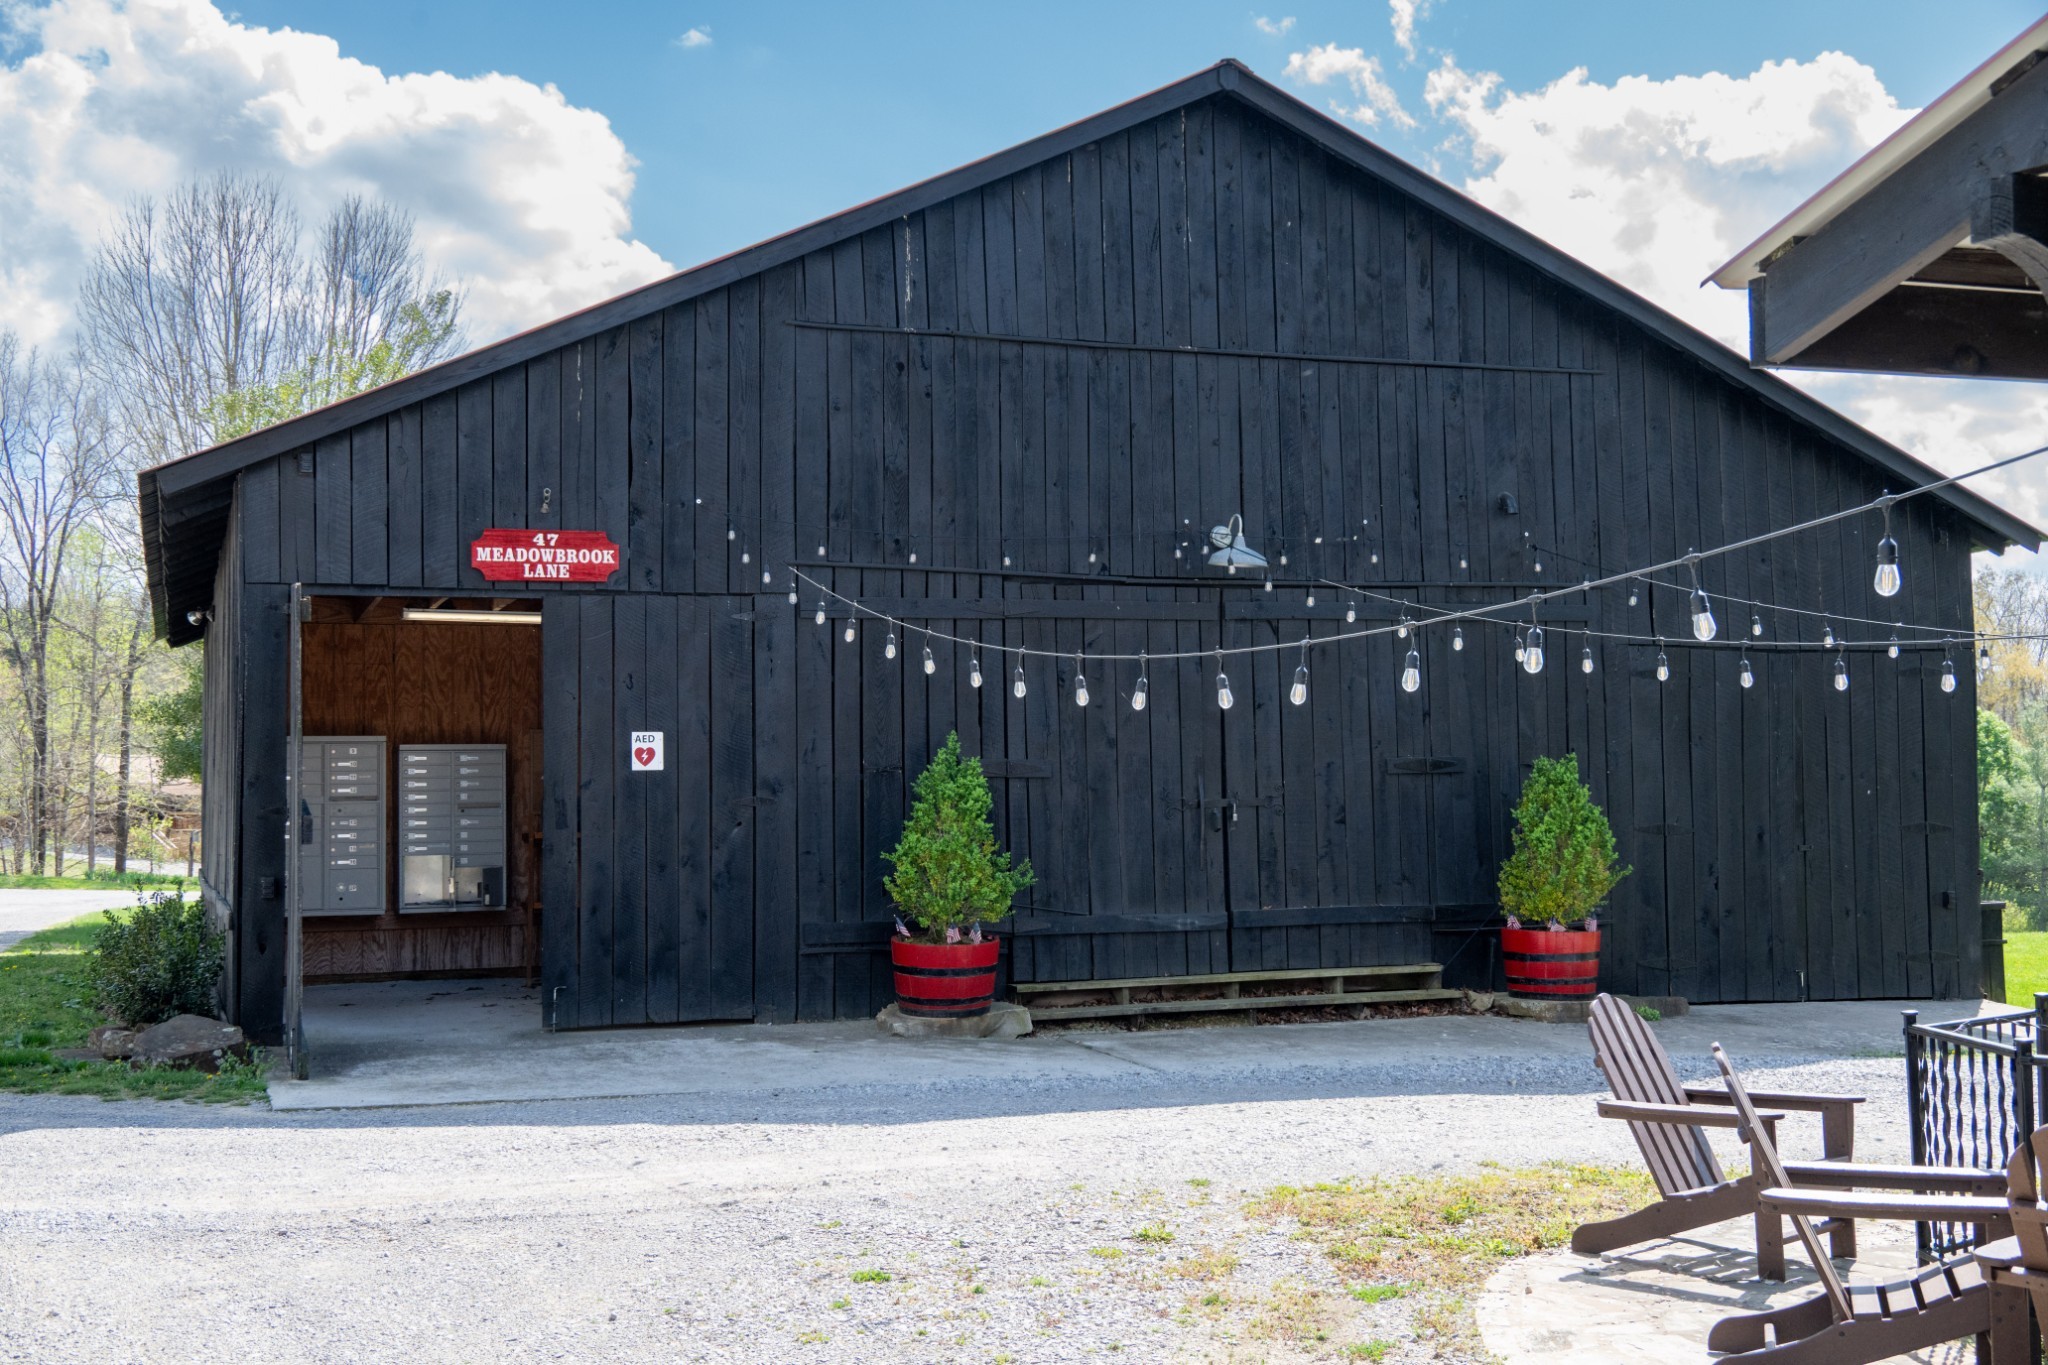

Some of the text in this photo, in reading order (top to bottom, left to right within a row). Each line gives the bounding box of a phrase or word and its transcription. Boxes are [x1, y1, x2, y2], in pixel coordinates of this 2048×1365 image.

[532, 533, 559, 546] 47
[476, 547, 615, 564] MEADOWBROOK
[523, 563, 570, 578] LANE
[634, 734, 656, 743] AED
